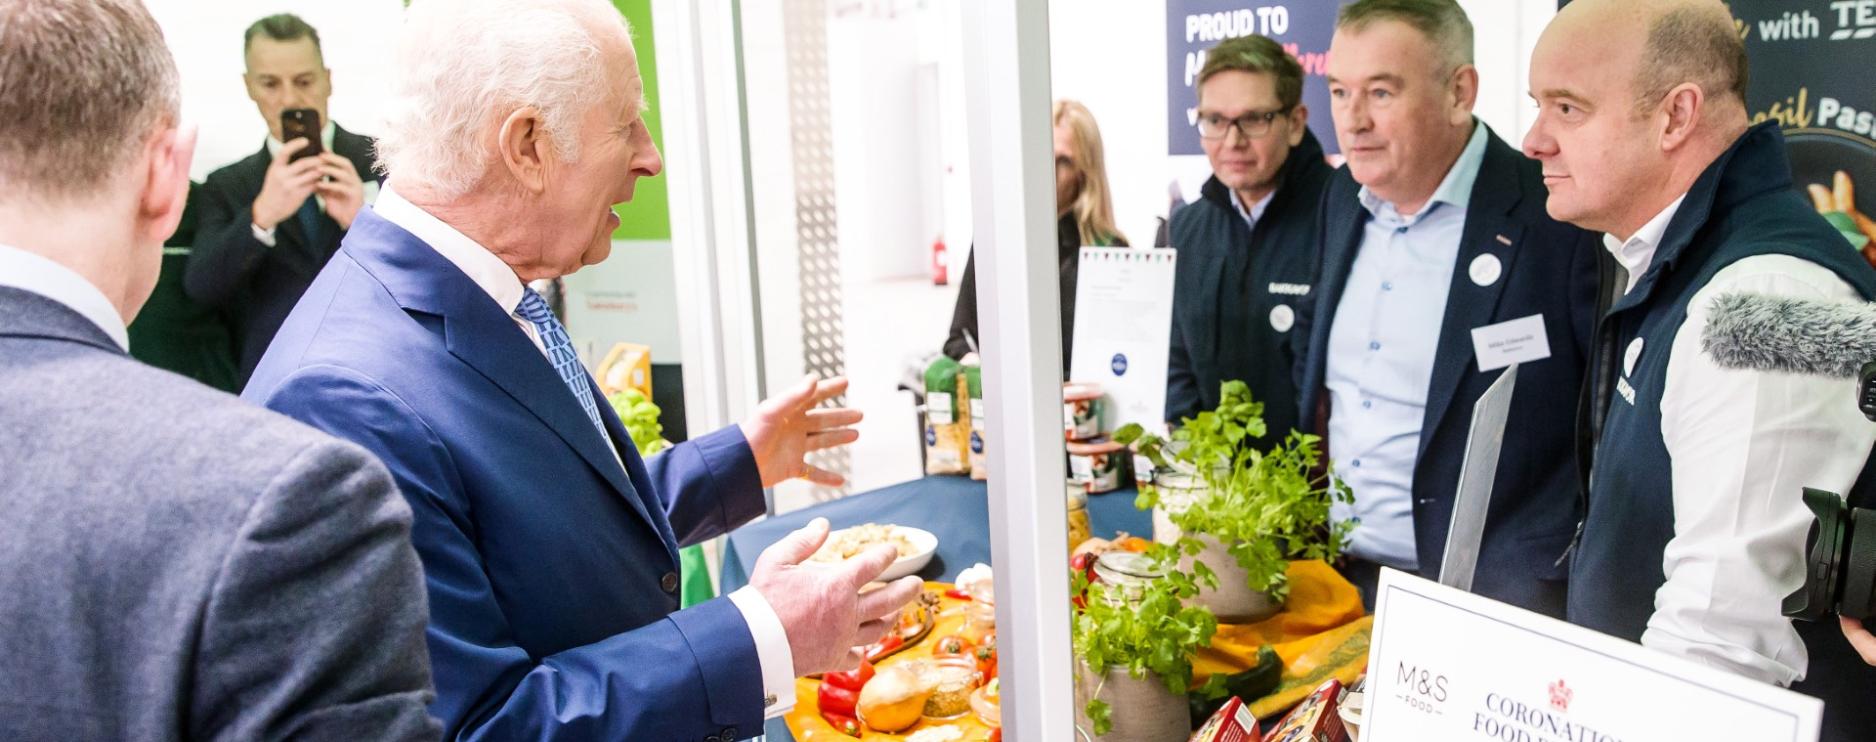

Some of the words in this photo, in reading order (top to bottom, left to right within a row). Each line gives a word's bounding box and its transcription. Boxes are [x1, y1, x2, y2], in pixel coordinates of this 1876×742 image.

[1185, 9, 1254, 43] PROUD
[1257, 6, 1289, 36] TO
[1758, 10, 1819, 41] with
[1829, 0, 1876, 28] TE
[1749, 87, 1813, 128] asil
[1817, 97, 1876, 139] Pas
[1397, 661, 1448, 702] M&S
[1404, 694, 1434, 713] FOOD
[1473, 712, 1530, 742] FOOD
